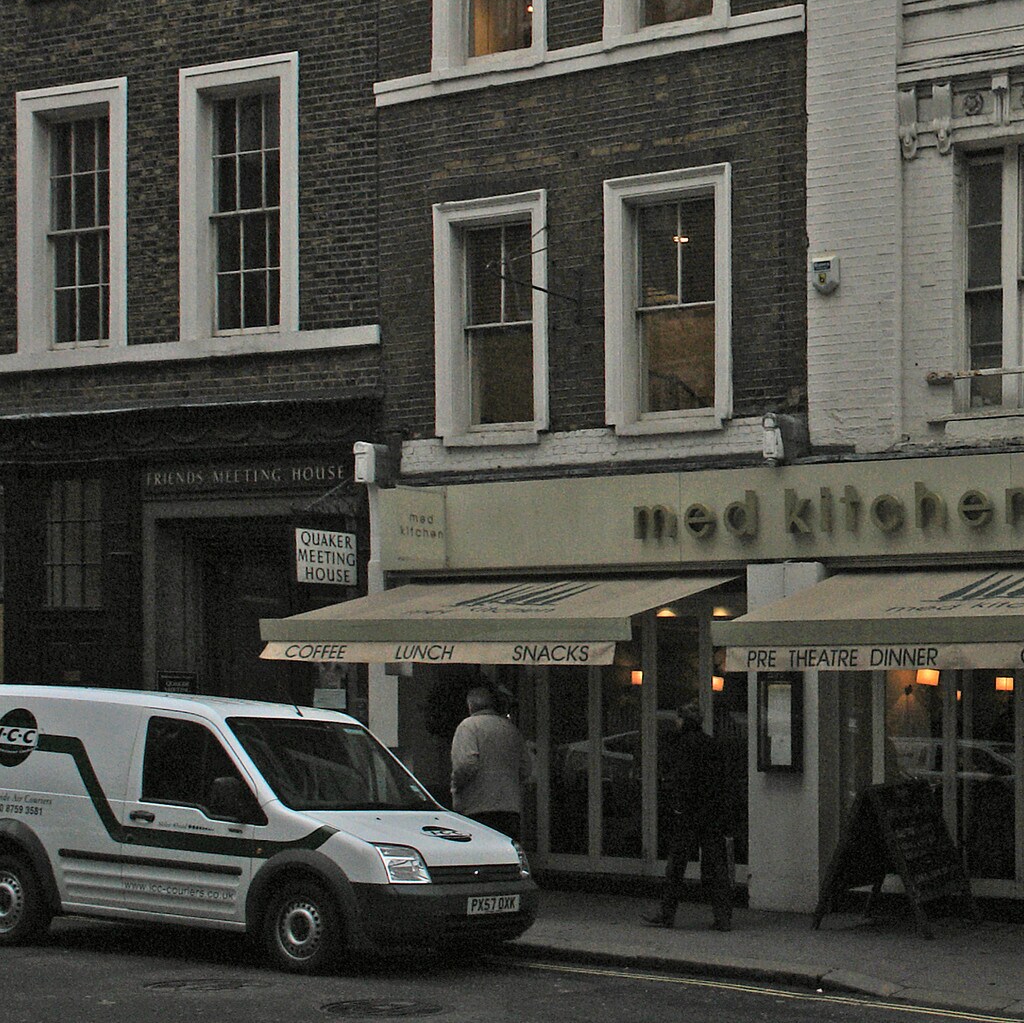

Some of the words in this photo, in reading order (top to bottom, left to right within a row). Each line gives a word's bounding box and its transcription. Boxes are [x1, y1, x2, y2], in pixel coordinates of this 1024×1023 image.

[146, 471, 203, 486] FRIENDS
[212, 468, 282, 483] MEETING
[291, 465, 345, 481] HOUSE
[633, 490, 759, 542] med
[300, 530, 353, 549] QUAKER
[400, 525, 444, 539] kitchen
[298, 549, 356, 567] MEETING
[305, 566, 351, 583] HOUSE
[284, 644, 347, 660] COFFEE
[394, 644, 455, 661] LUNCH
[512, 644, 590, 662] SNACKS
[747, 650, 777, 668] PRE
[789, 648, 859, 668] THEATRE
[870, 647, 939, 667] DINNER
[5, 805, 24, 813] 8759
[26, 806, 43, 816] 3581
[471, 898, 497, 911] PX57
